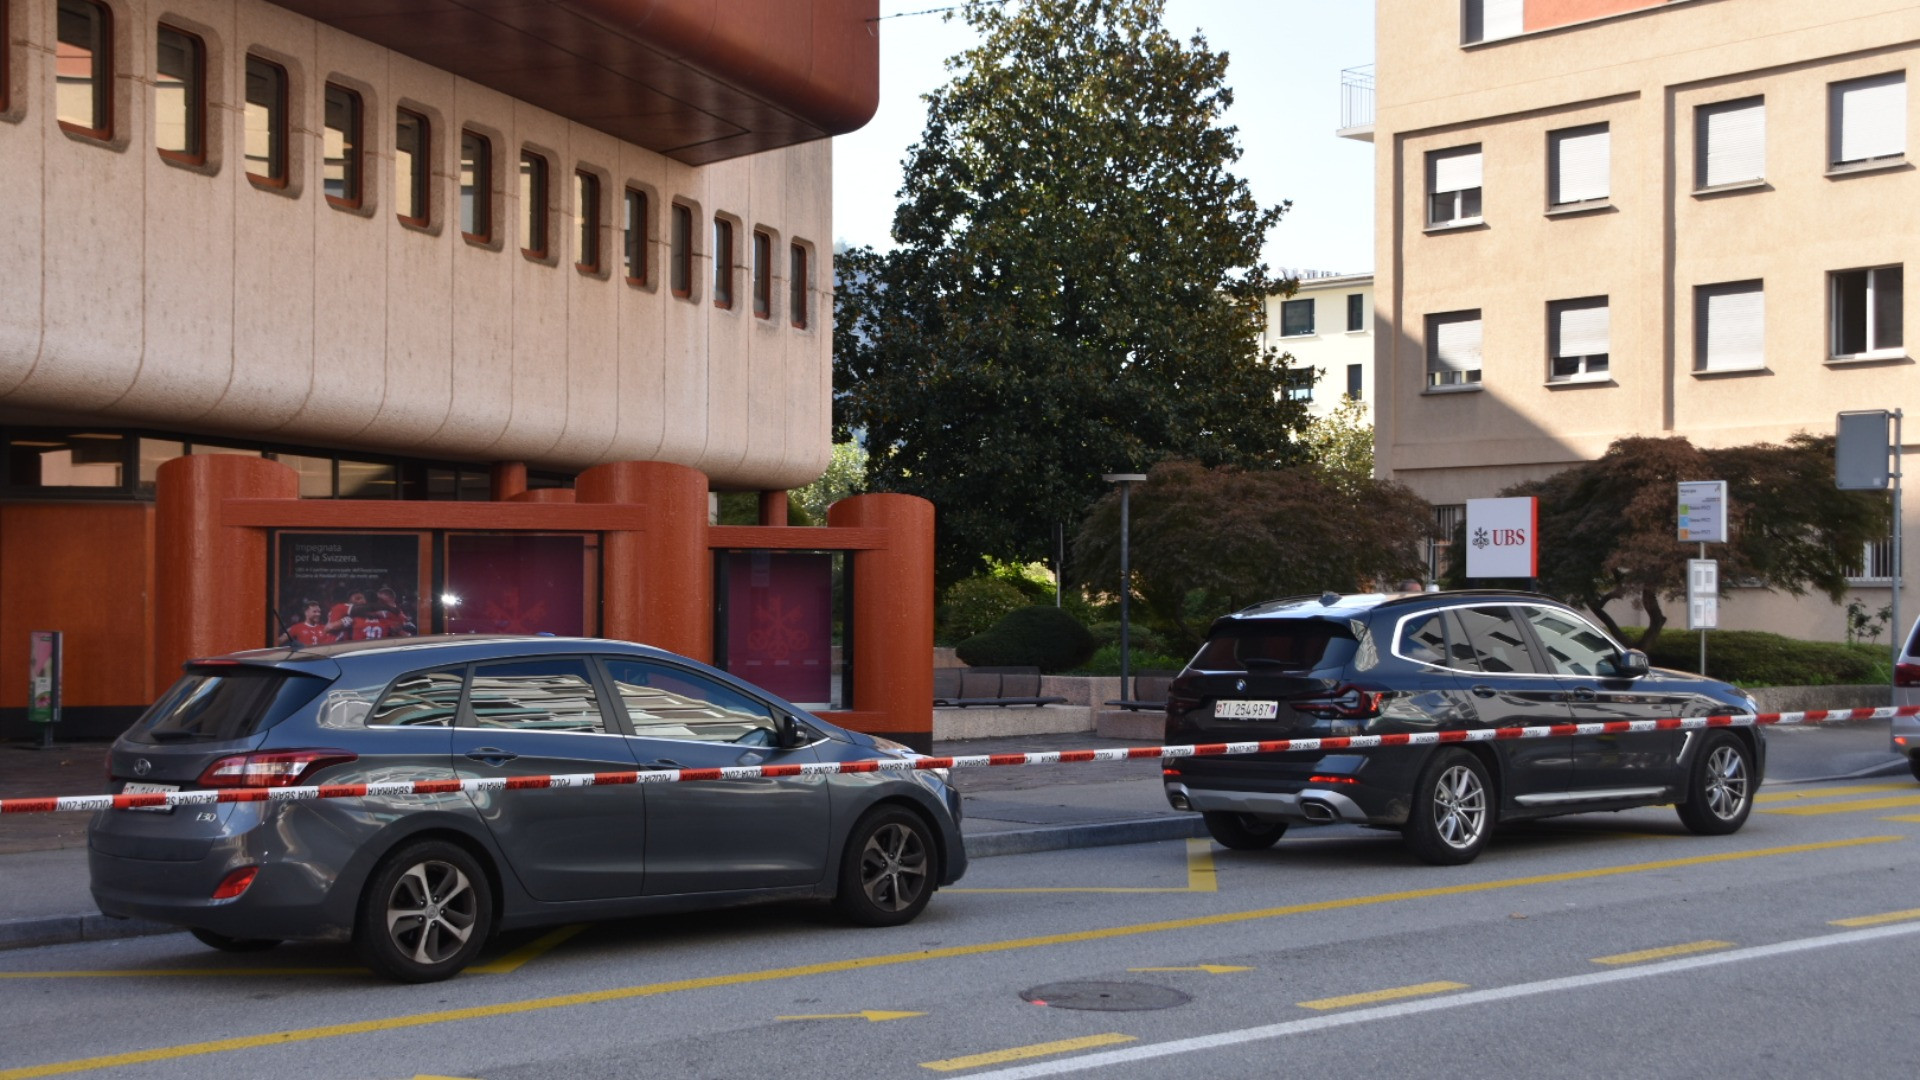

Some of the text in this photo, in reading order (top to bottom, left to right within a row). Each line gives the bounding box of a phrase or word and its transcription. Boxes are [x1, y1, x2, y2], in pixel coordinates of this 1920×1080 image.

[1492, 528, 1525, 546] UBS
[295, 544, 342, 553] Impegnata
[295, 553, 359, 563] per la Svizzera.
[1222, 703, 1232, 715] TI
